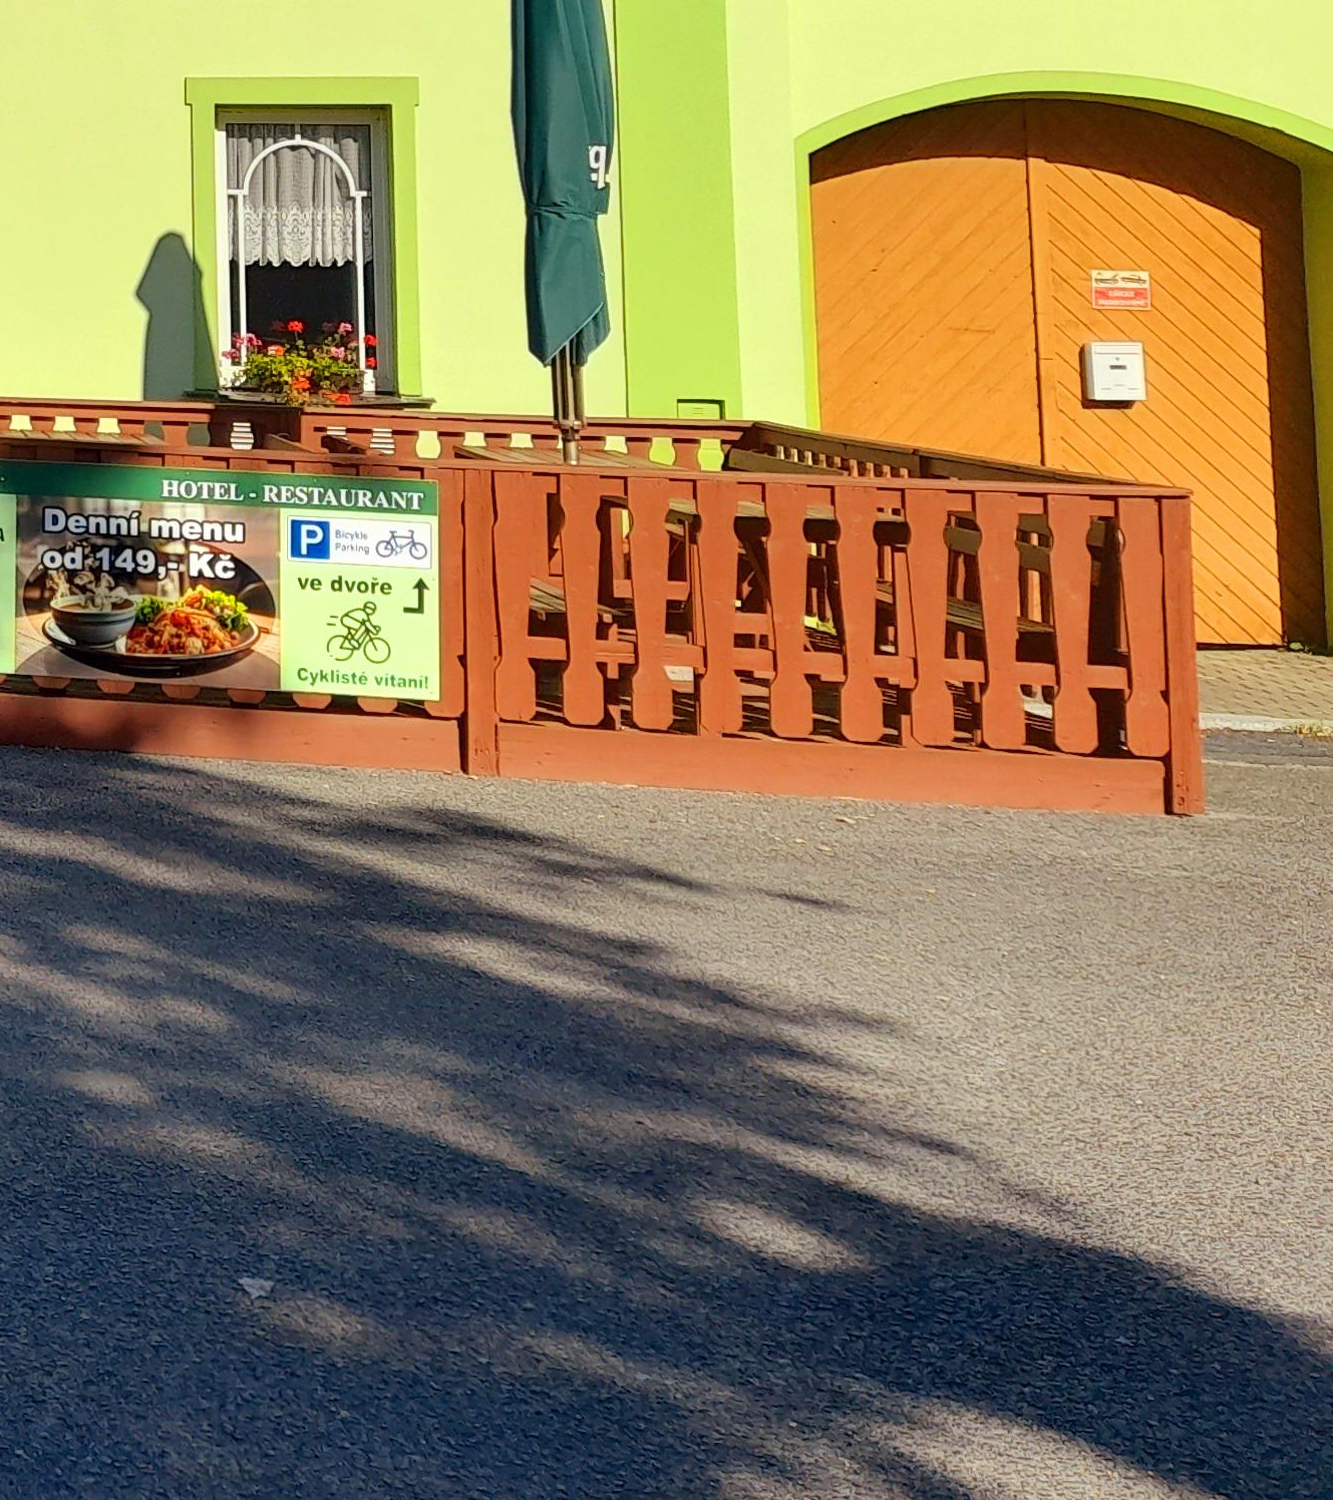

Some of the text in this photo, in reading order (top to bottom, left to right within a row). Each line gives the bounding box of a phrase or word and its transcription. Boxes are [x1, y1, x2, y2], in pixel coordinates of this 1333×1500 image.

[161, 479, 244, 501] HOTEL
[263, 485, 424, 511] RESTAURANT
[43, 507, 245, 543] Denní menu
[300, 524, 324, 555] P
[42, 546, 237, 580] od 149,- Kč
[298, 575, 393, 595] ve dvoře
